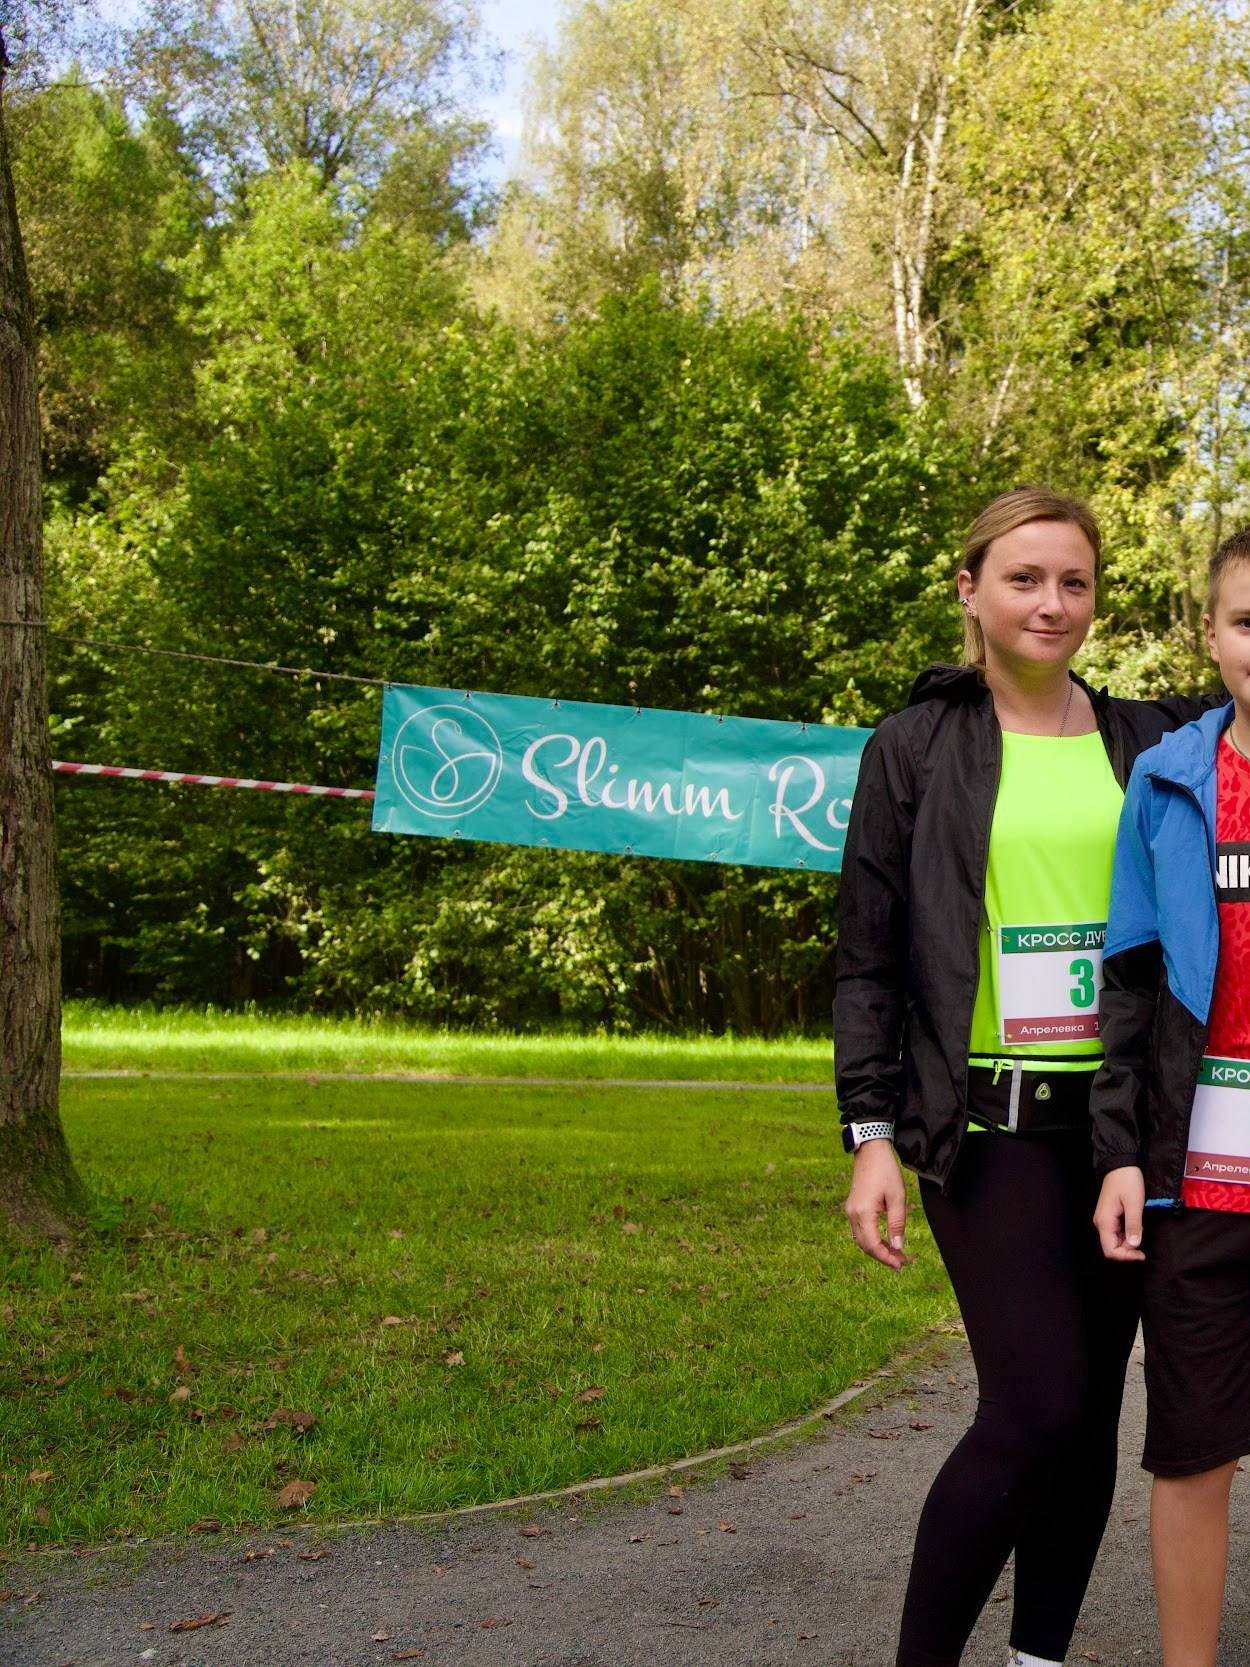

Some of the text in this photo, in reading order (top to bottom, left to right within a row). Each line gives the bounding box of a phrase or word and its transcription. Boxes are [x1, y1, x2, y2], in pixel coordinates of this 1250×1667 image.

[522, 734, 853, 851] Slimm Ro
[1018, 929, 1106, 947] КРОСС ДУБ
[1069, 958, 1095, 1008] 3
[1020, 1024, 1085, 1036] Апрелевка
